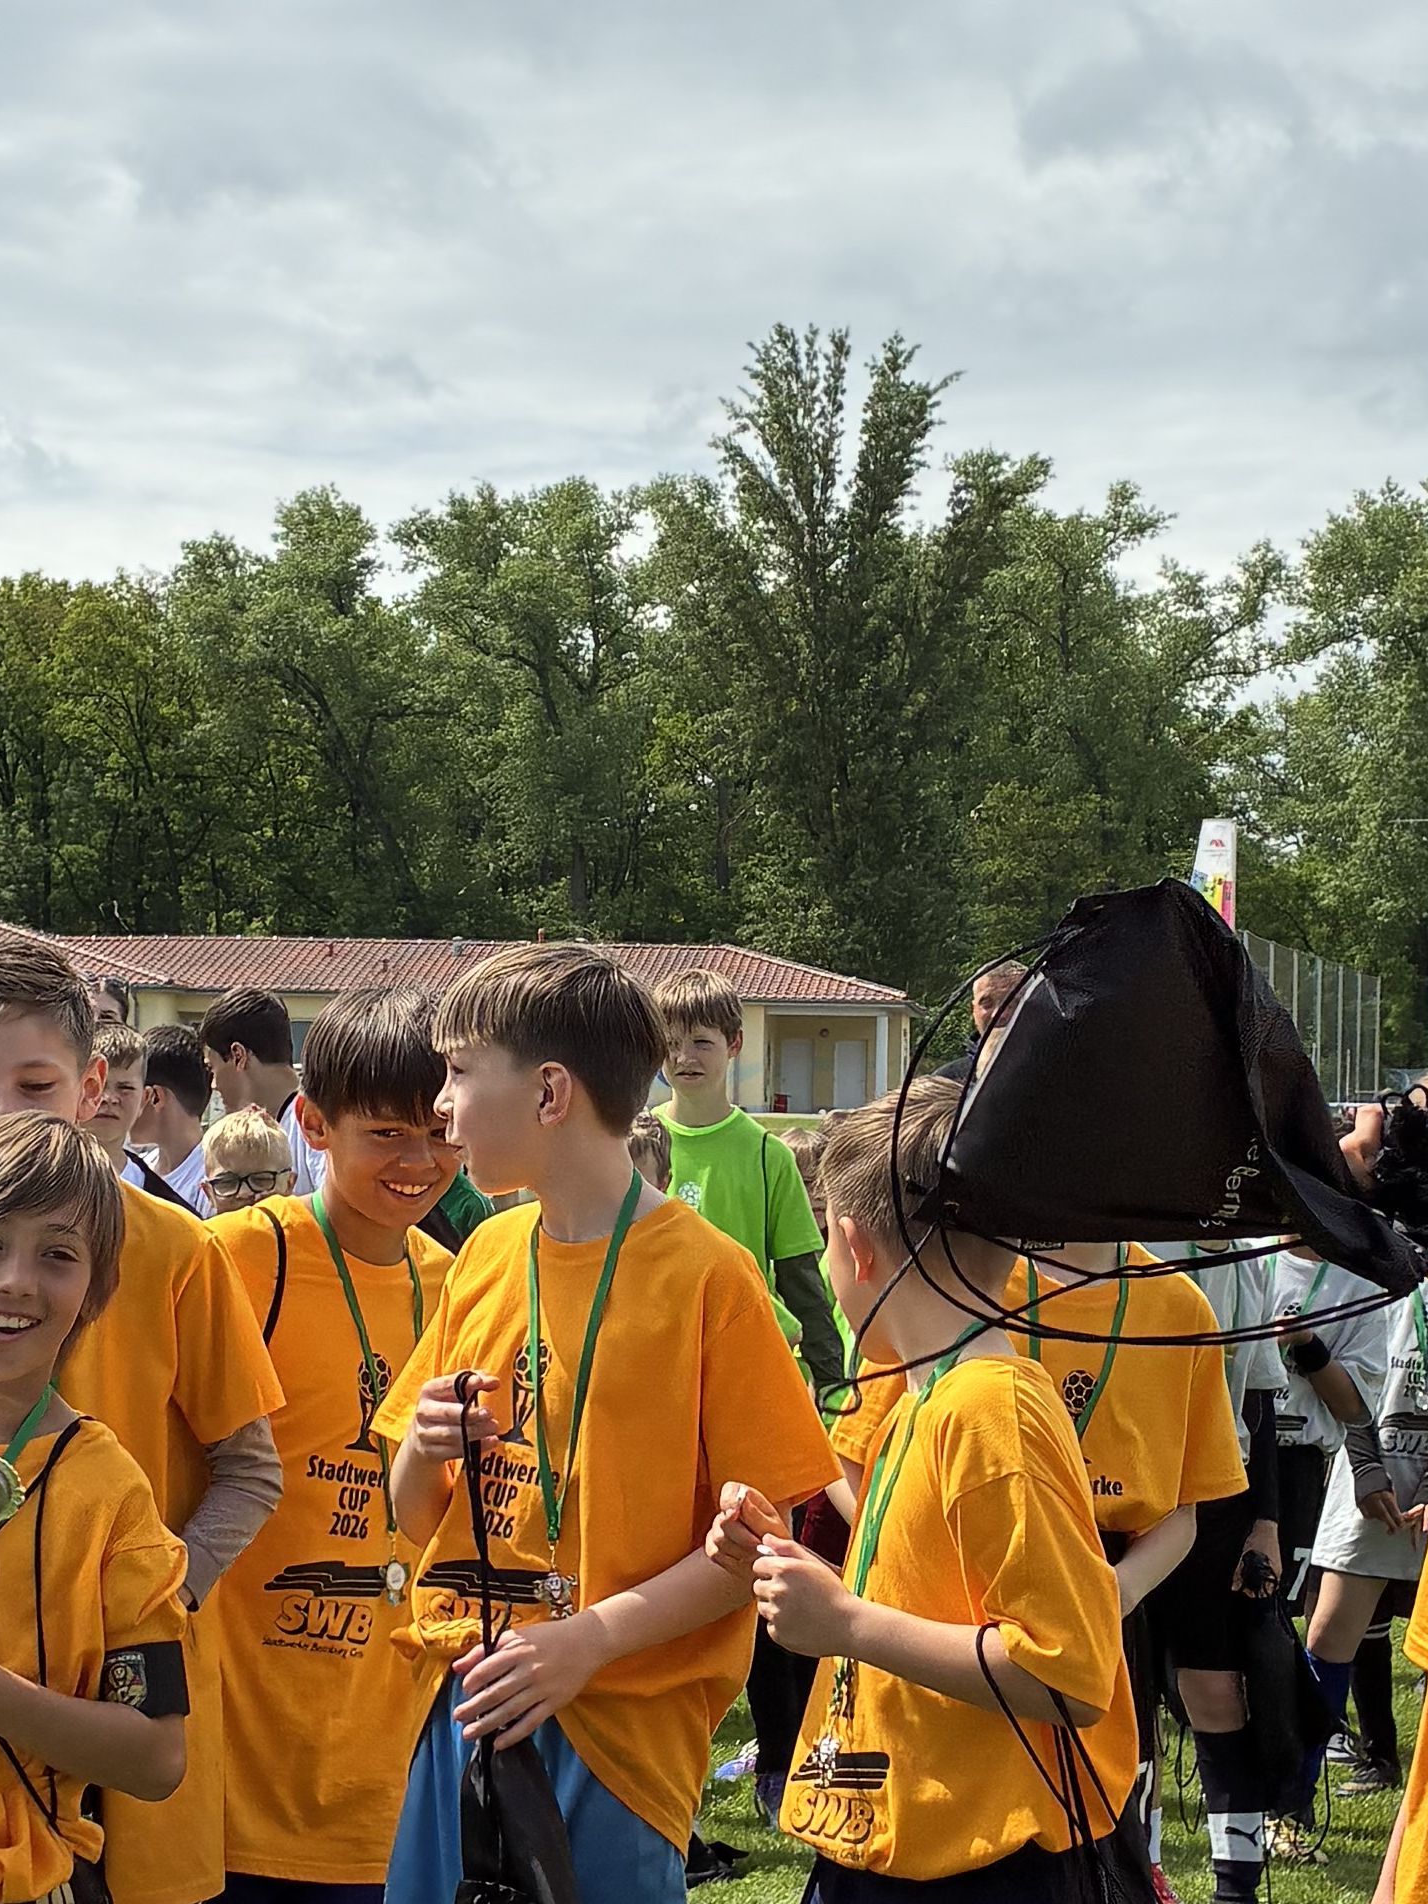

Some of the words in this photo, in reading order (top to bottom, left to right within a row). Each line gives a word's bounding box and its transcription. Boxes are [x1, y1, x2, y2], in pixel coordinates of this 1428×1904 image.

[307, 1454, 385, 1488] Stadtwer
[338, 1486, 371, 1513] CUP
[483, 1480, 519, 1510] CUP
[329, 1512, 370, 1540] 2026
[484, 1509, 516, 1539] 026
[275, 1596, 374, 1645] SWB
[789, 1786, 876, 1845] SWB
